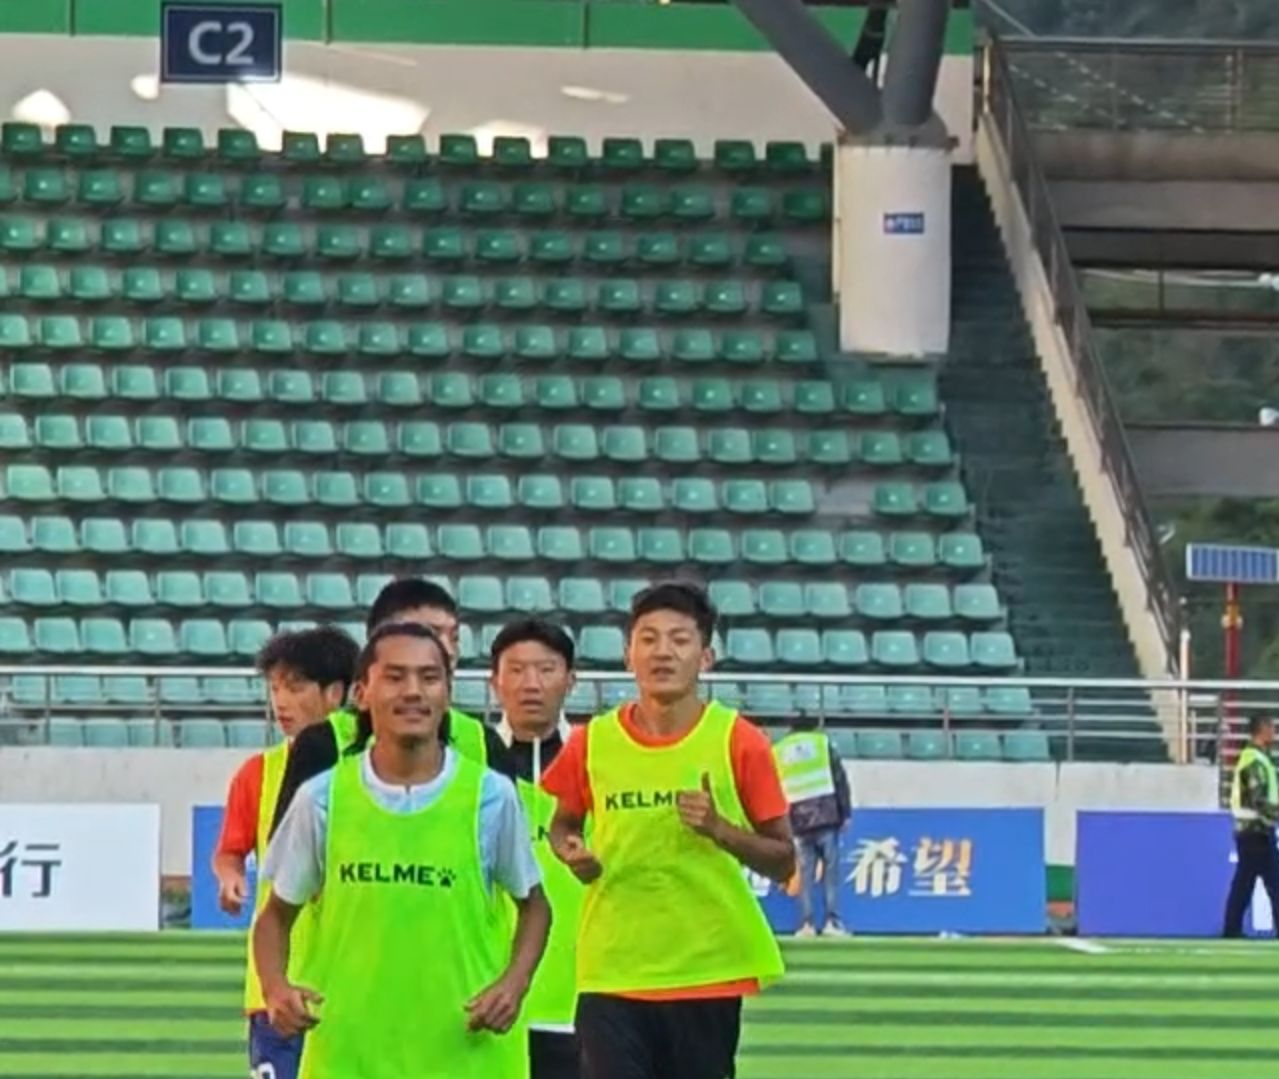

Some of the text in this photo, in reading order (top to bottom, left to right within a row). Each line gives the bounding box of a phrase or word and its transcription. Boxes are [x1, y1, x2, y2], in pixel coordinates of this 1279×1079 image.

[188, 21, 254, 65] C2
[0, 840, 62, 898] 行
[340, 862, 435, 887] KELME
[844, 836, 972, 898] 希望
